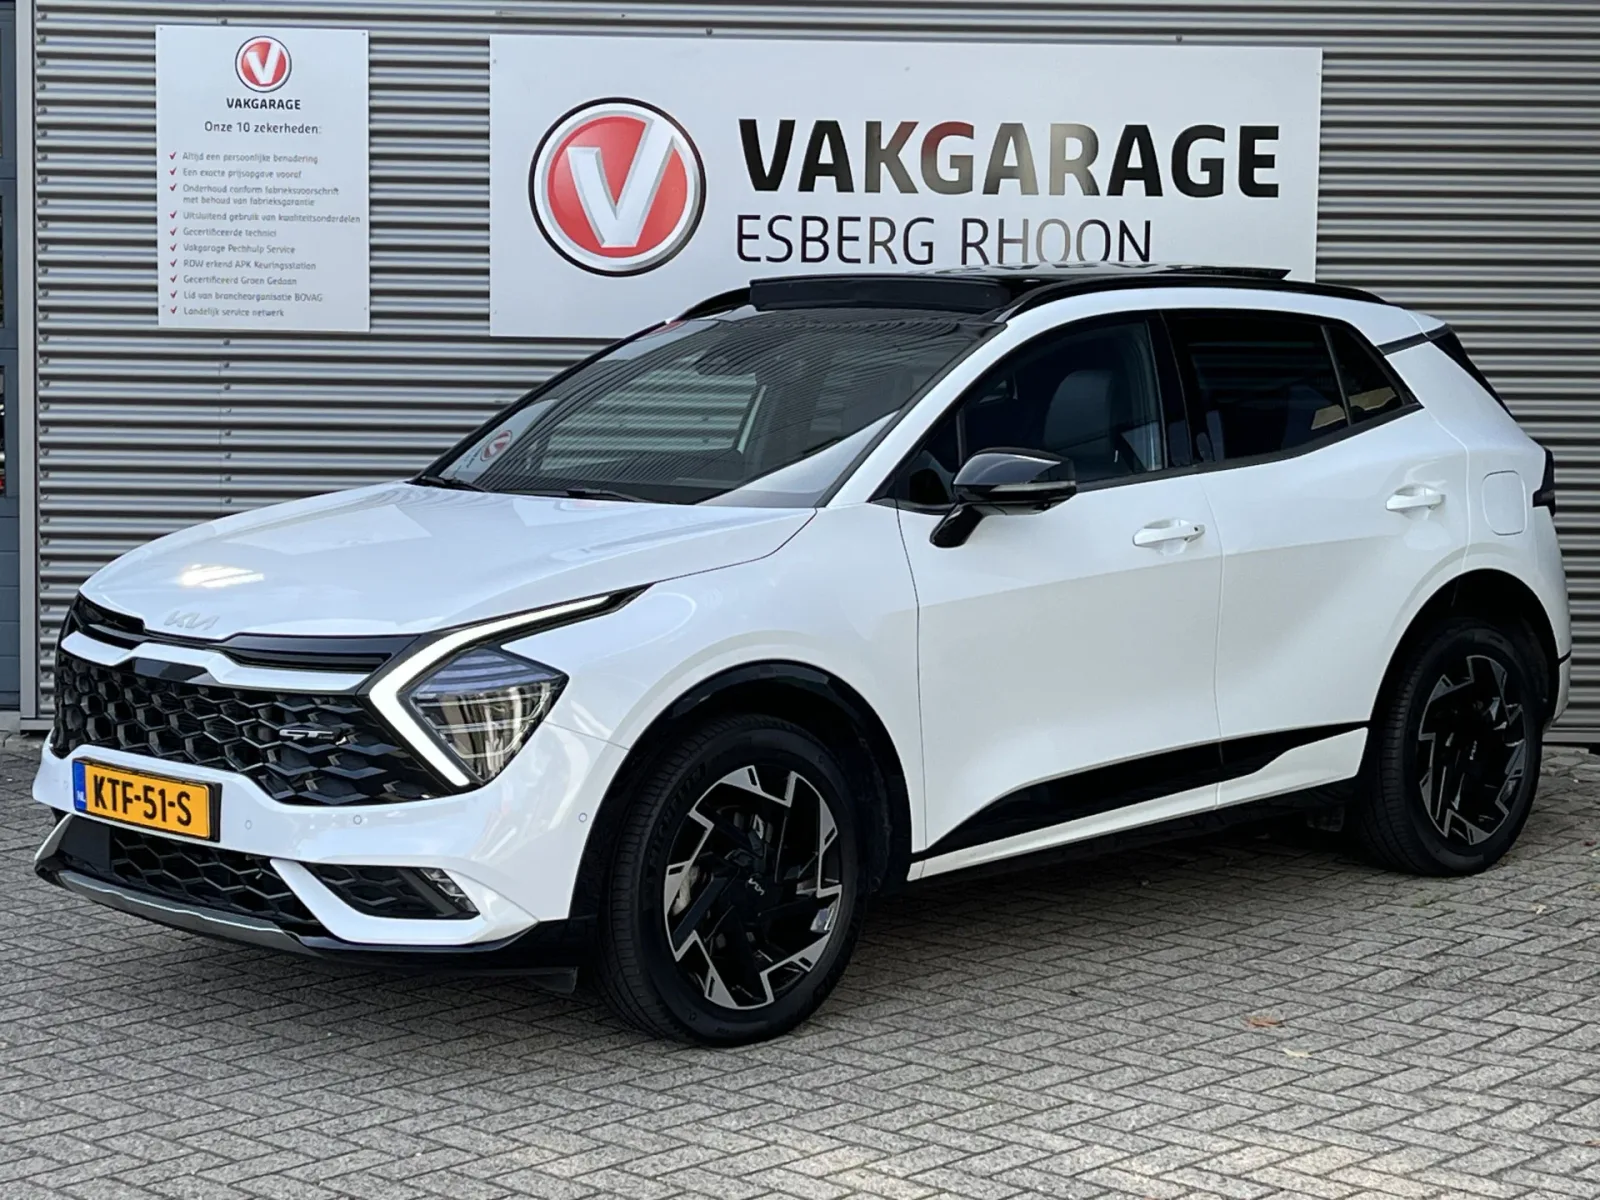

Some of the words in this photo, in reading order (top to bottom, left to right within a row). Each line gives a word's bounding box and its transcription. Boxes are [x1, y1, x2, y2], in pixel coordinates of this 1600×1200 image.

[226, 98, 301, 110] VAKGARAGE
[204, 121, 232, 132] Onze
[237, 122, 250, 132] 10
[223, 153, 270, 162] persoonlijke
[738, 118, 1280, 198] VAKGARAGE
[183, 168, 197, 176] Een
[183, 184, 227, 193] Onderhoud
[201, 196, 230, 204] behoud
[736, 214, 935, 266] ESBERG
[961, 217, 1152, 266] RHOON
[183, 244, 225, 253] Vakgarage
[267, 245, 295, 254] Service
[184, 259, 203, 268] RDW
[206, 260, 232, 268] erkend
[235, 260, 251, 269] APK
[240, 276, 264, 285] Groen
[184, 290, 196, 300] Lid
[198, 292, 212, 300] van
[294, 292, 323, 301] BOVAG
[222, 308, 249, 316] service
[252, 308, 284, 317] netwerk
[93, 774, 192, 826] KTF-51-S
